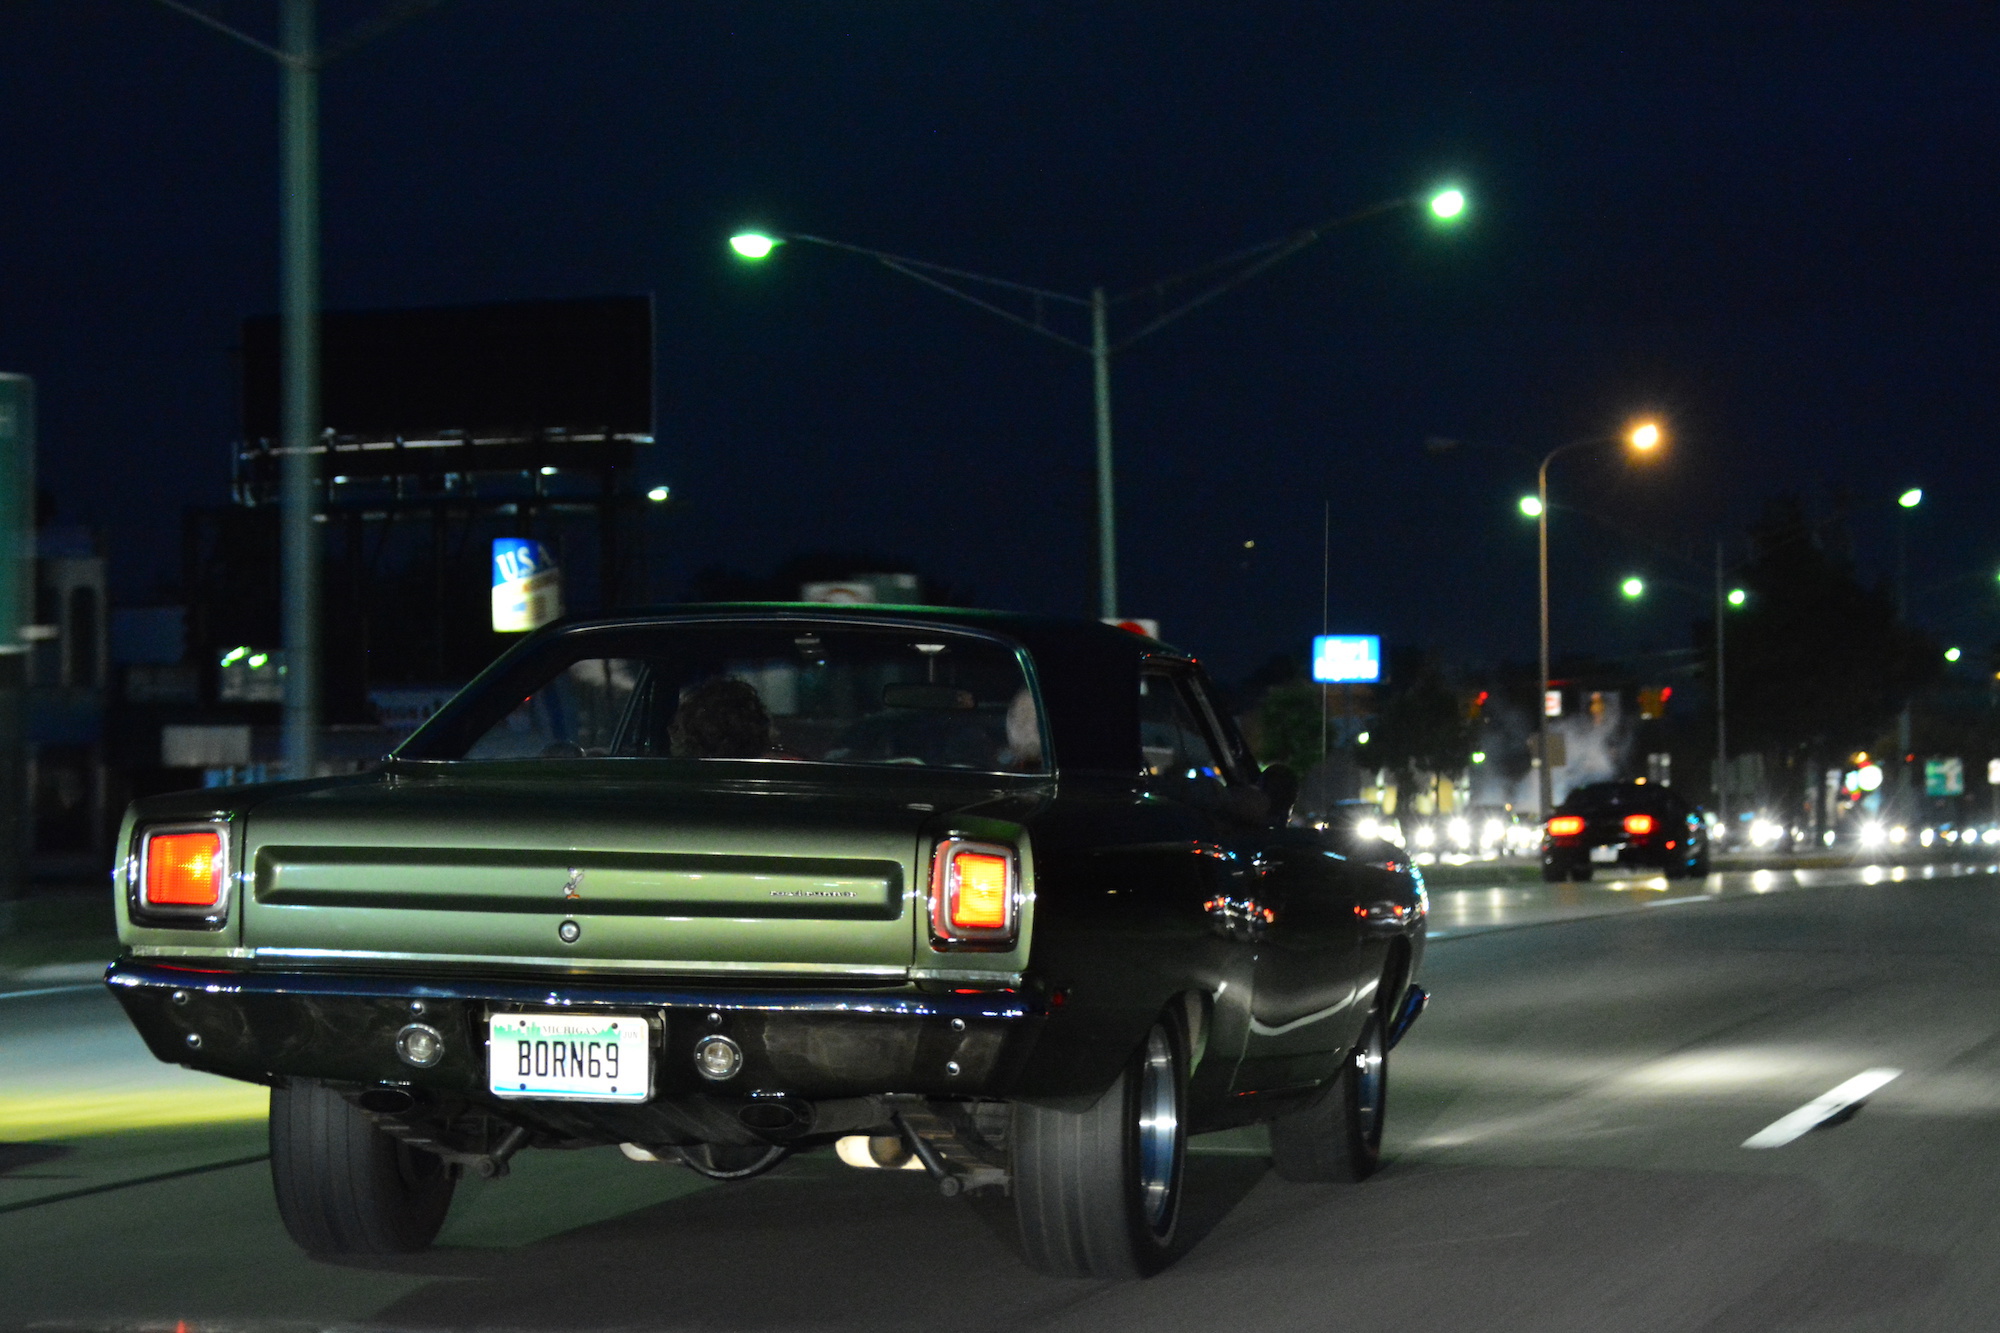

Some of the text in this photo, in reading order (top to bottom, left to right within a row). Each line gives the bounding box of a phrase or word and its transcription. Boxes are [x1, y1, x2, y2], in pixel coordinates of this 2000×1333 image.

[542, 1025, 599, 1035] MICHIGAN
[623, 1031, 638, 1039] JUN
[518, 1040, 619, 1079] BORN69
